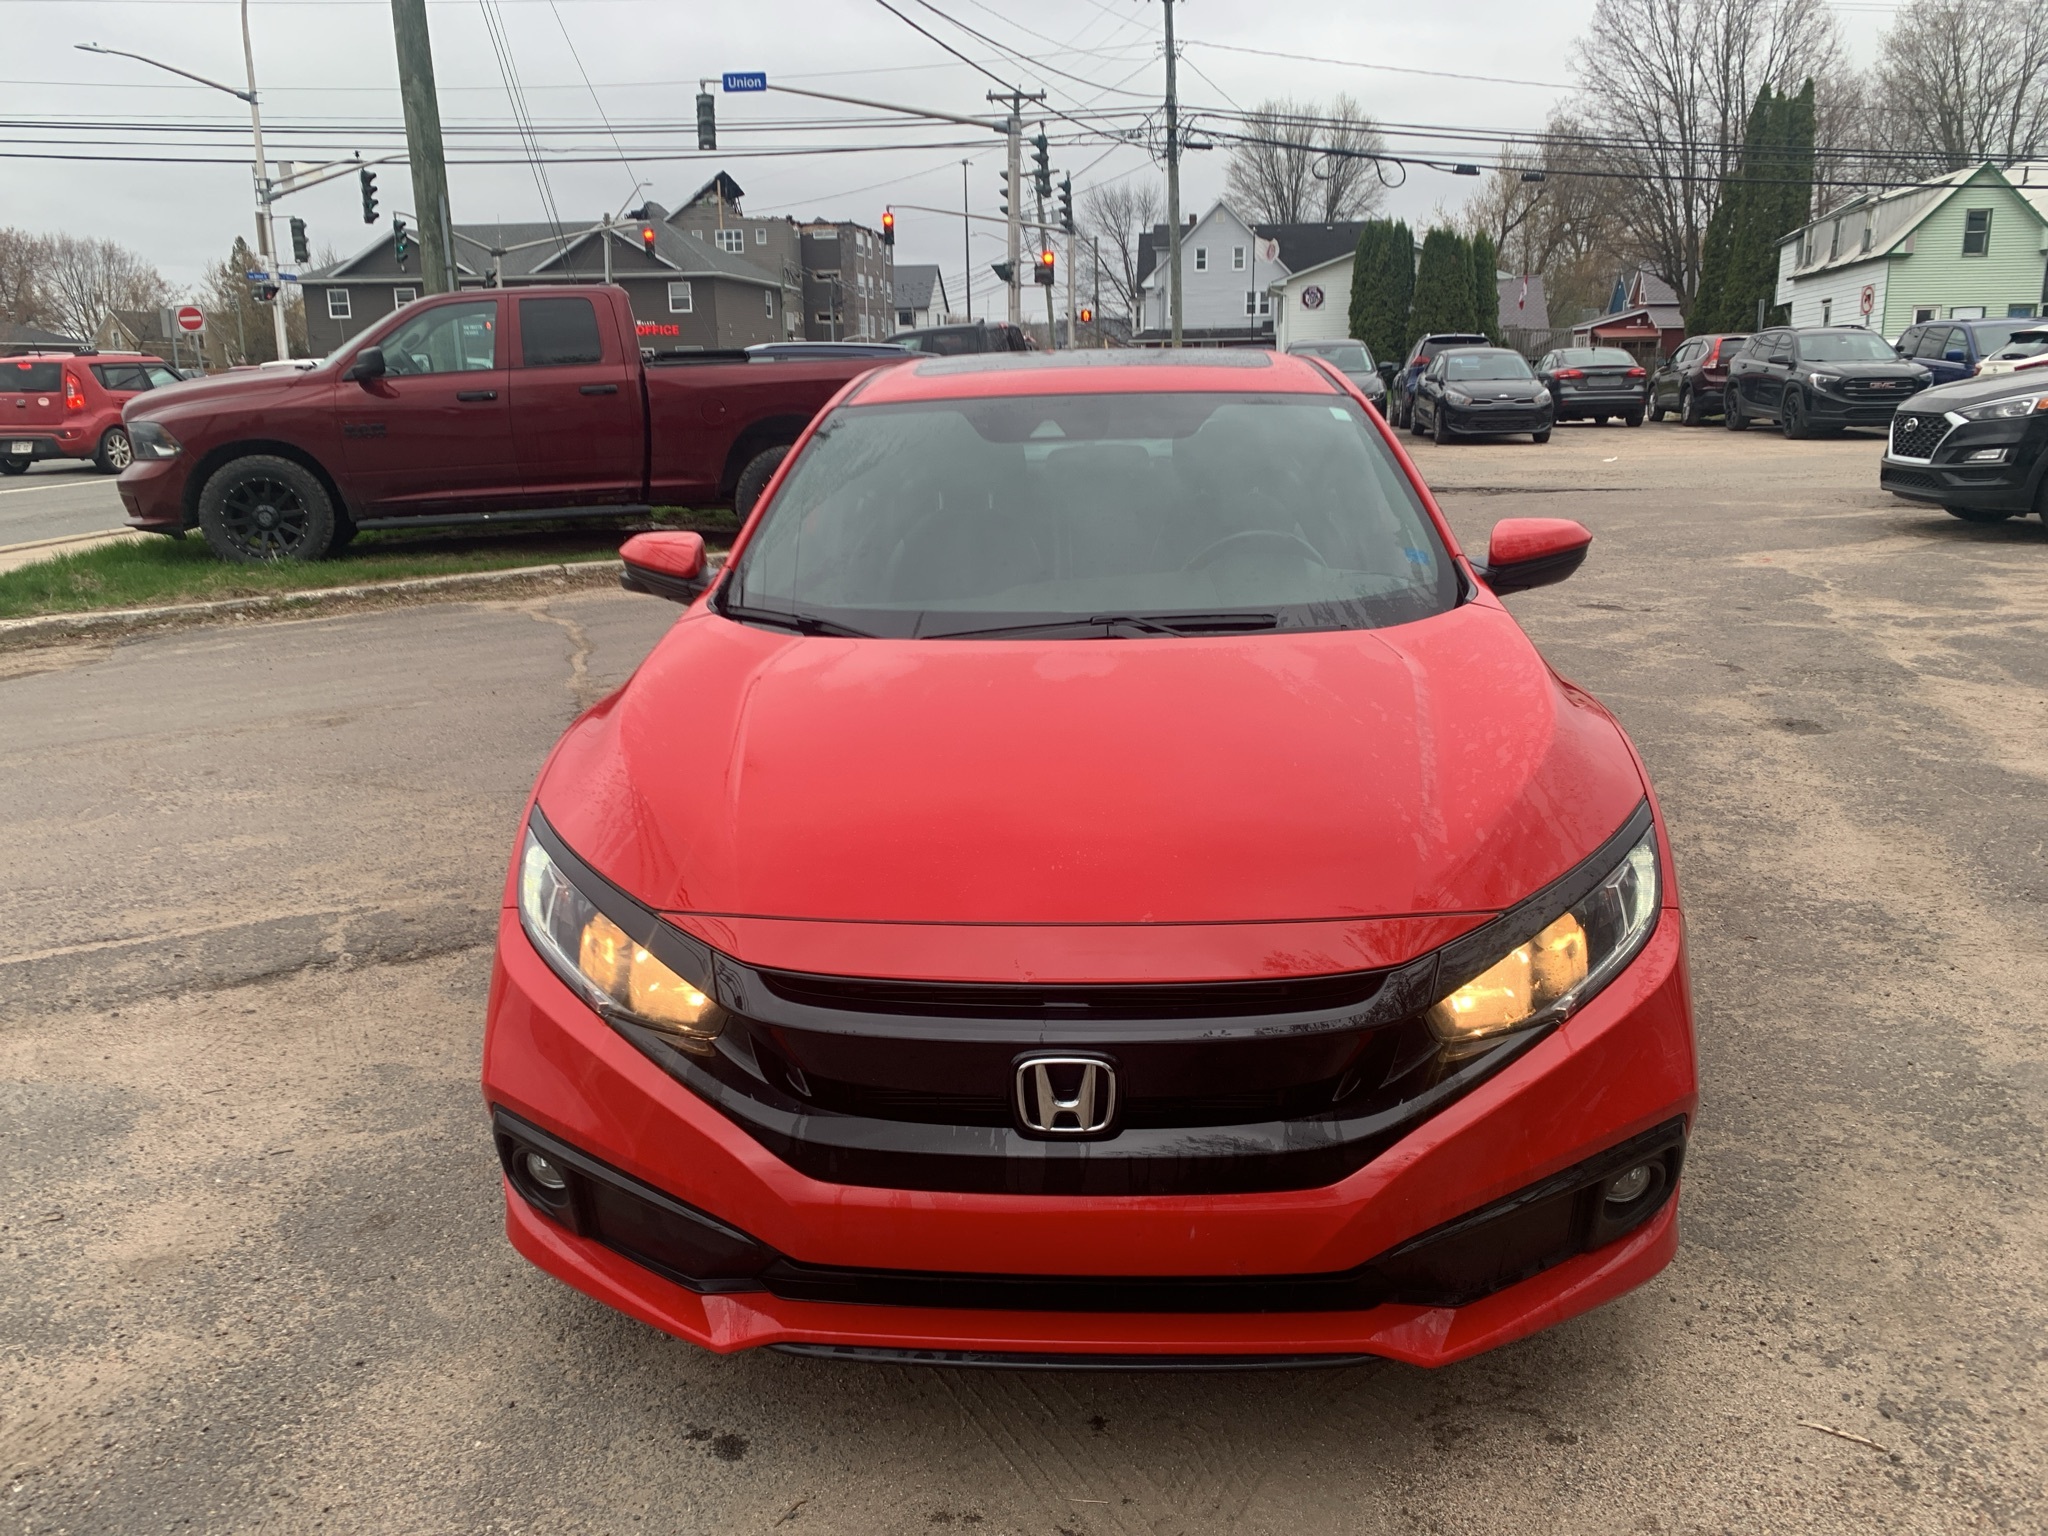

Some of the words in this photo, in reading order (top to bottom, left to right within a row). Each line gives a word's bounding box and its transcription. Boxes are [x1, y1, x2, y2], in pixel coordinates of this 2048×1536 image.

[728, 76, 762, 89] Union
[636, 325, 680, 336] OFFICE
[1870, 381, 1896, 389] GMC
